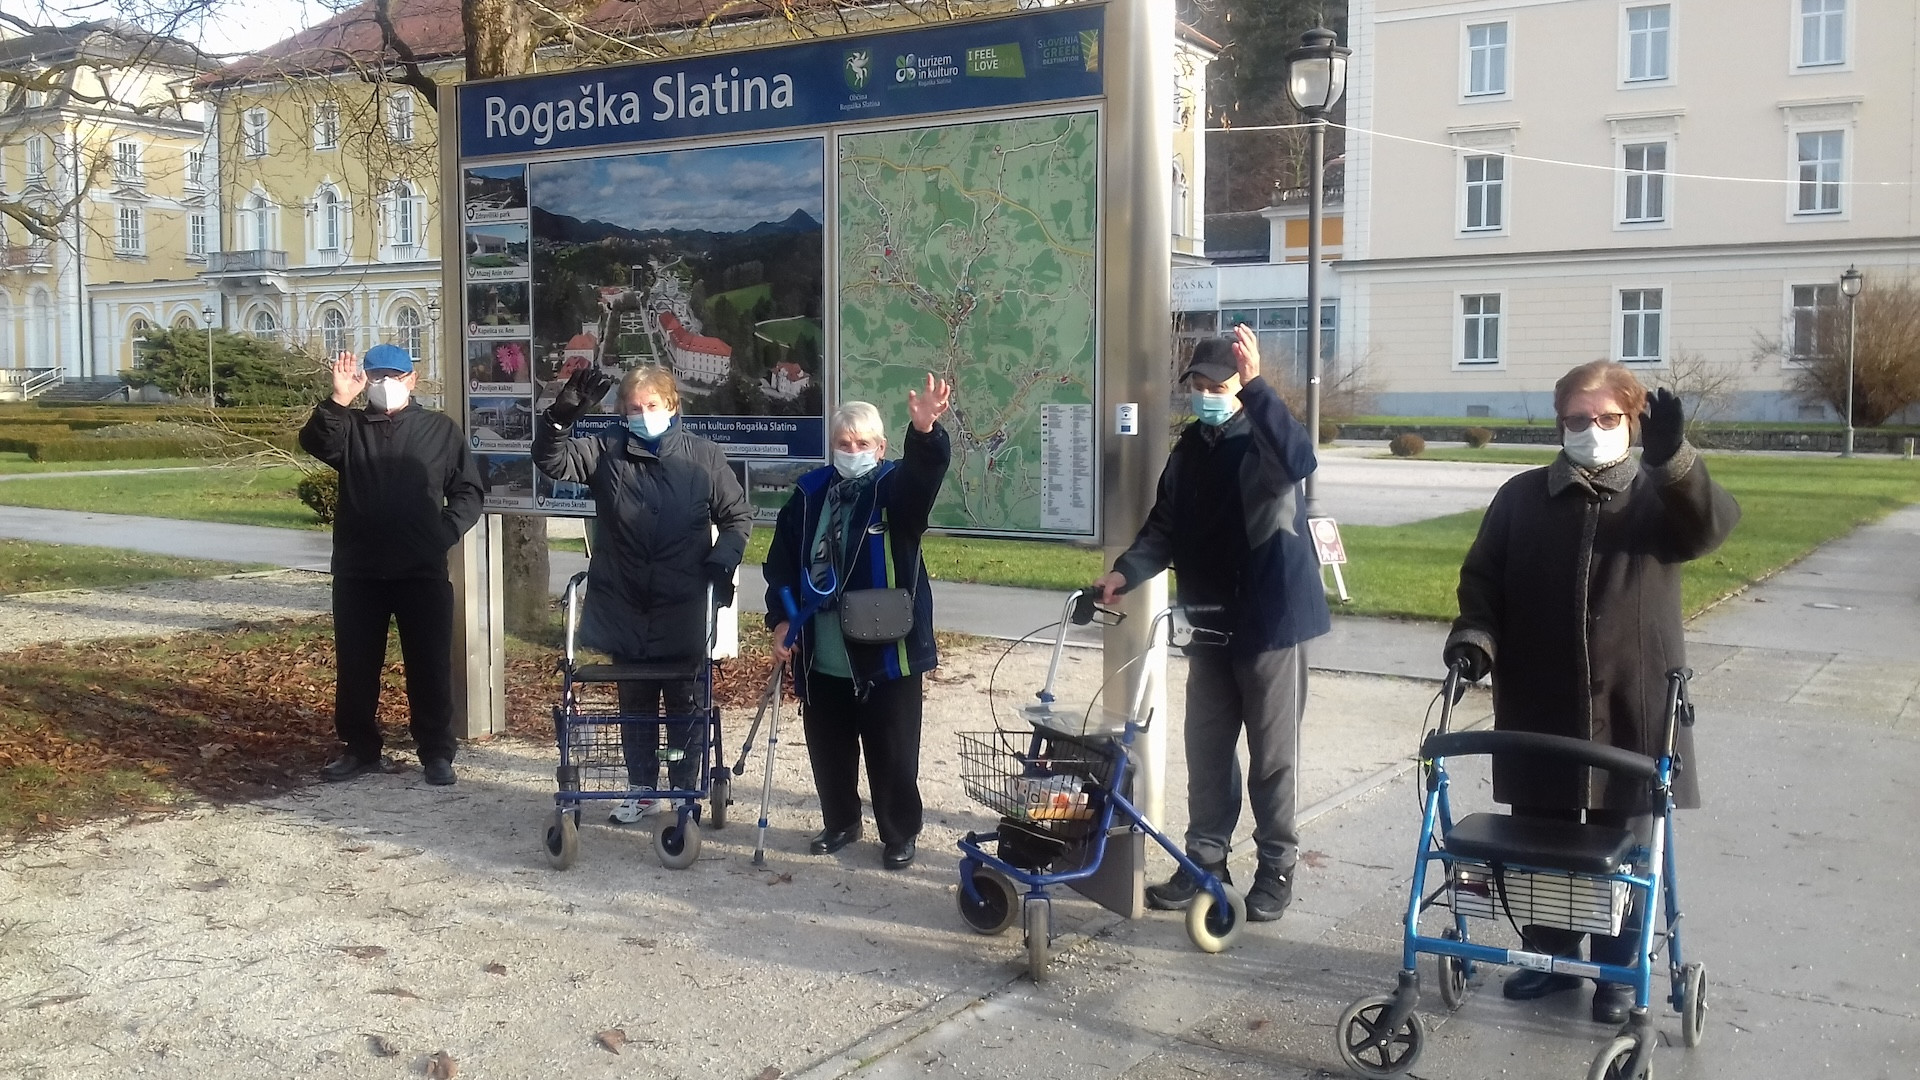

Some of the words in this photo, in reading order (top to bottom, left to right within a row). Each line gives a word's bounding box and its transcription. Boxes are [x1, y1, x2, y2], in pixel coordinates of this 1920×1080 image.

[1037, 35, 1079, 49] SLOVENIA
[968, 50, 972, 61] I
[974, 48, 997, 60] FEEL
[1043, 45, 1079, 58] GREEN
[918, 54, 952, 68] turizem
[918, 69, 927, 80] in
[927, 65, 959, 79] kulturo
[485, 82, 640, 146] Rogaška
[652, 67, 794, 122] Slatina
[500, 211, 511, 219] park
[1172, 279, 1214, 290] GAŠKA
[576, 419, 618, 430] Informacij
[698, 422, 707, 430] in
[707, 421, 735, 431] kulturo
[736, 421, 769, 433] Rogaška
[769, 422, 797, 432] Slatina
